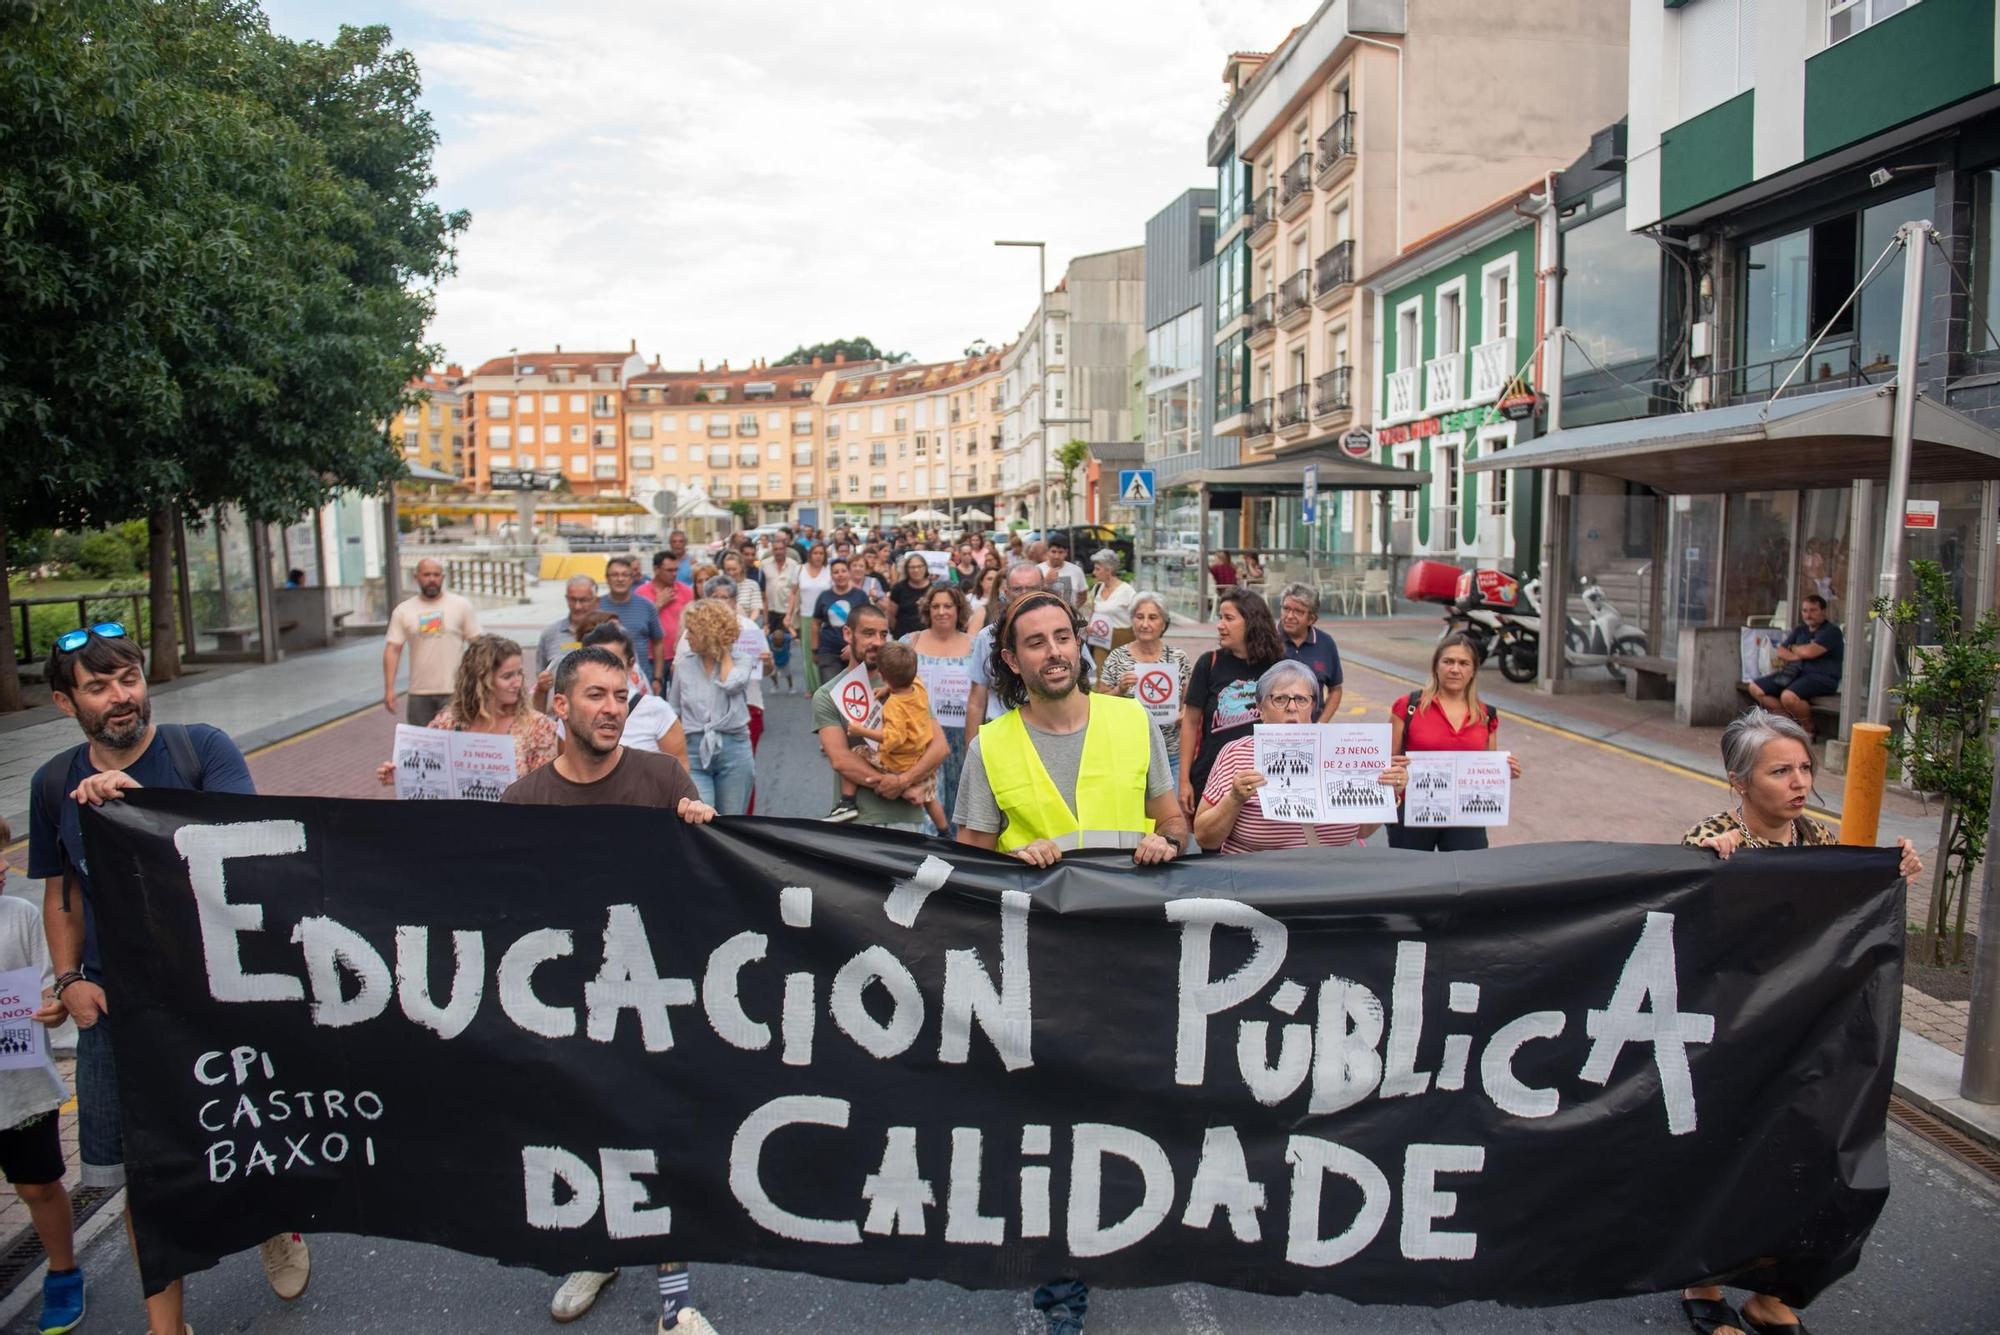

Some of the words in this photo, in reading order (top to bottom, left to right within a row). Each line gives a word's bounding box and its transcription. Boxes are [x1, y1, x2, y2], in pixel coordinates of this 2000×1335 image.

[474, 751, 503, 760] NENOS
[1335, 746, 1346, 755] 23
[1348, 746, 1379, 755] NENOS
[454, 760, 464, 768] DE
[486, 763, 511, 772] ANOS
[1323, 760, 1335, 769] DE
[1337, 760, 1343, 769] 2
[1353, 760, 1358, 769] 3
[1360, 760, 1386, 769] ANOS
[1476, 767, 1501, 775] NENOS
[172, 818, 1036, 1073] EDUCACIÓN
[1164, 897, 1716, 1137] PÚBLICA
[0, 995, 20, 1006] OS
[0, 1007, 33, 1019] NOS
[193, 1045, 275, 1086] CPI
[198, 1089, 384, 1132] CASTRO
[204, 1131, 376, 1183] BAXOI
[522, 1145, 672, 1239] DE
[729, 1093, 1486, 1268] CALIDADE
